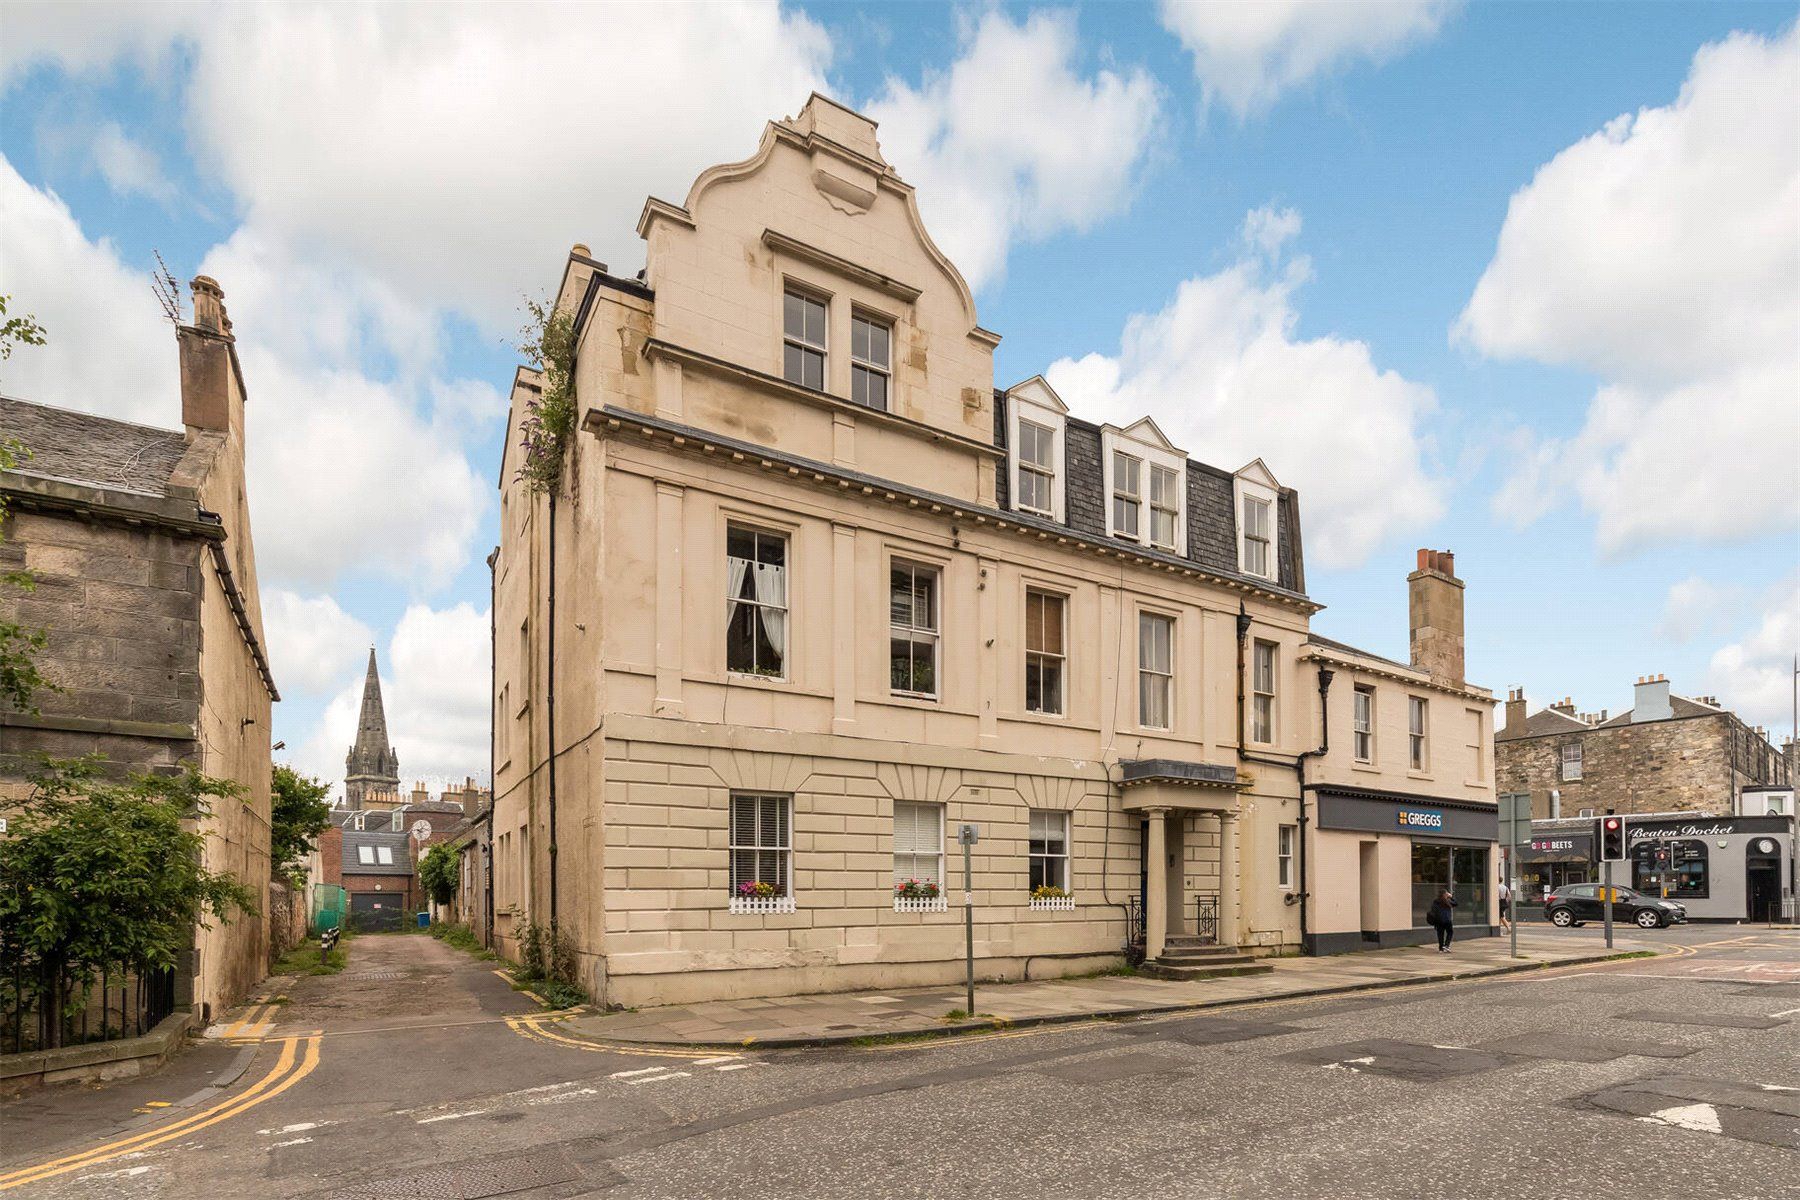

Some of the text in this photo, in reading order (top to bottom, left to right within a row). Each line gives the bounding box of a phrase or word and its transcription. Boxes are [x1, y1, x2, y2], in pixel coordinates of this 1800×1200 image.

[1408, 812, 1441, 827] GREGGS
[1629, 824, 1733, 838] Beaten Docket
[1551, 840, 1573, 849] BEETS
